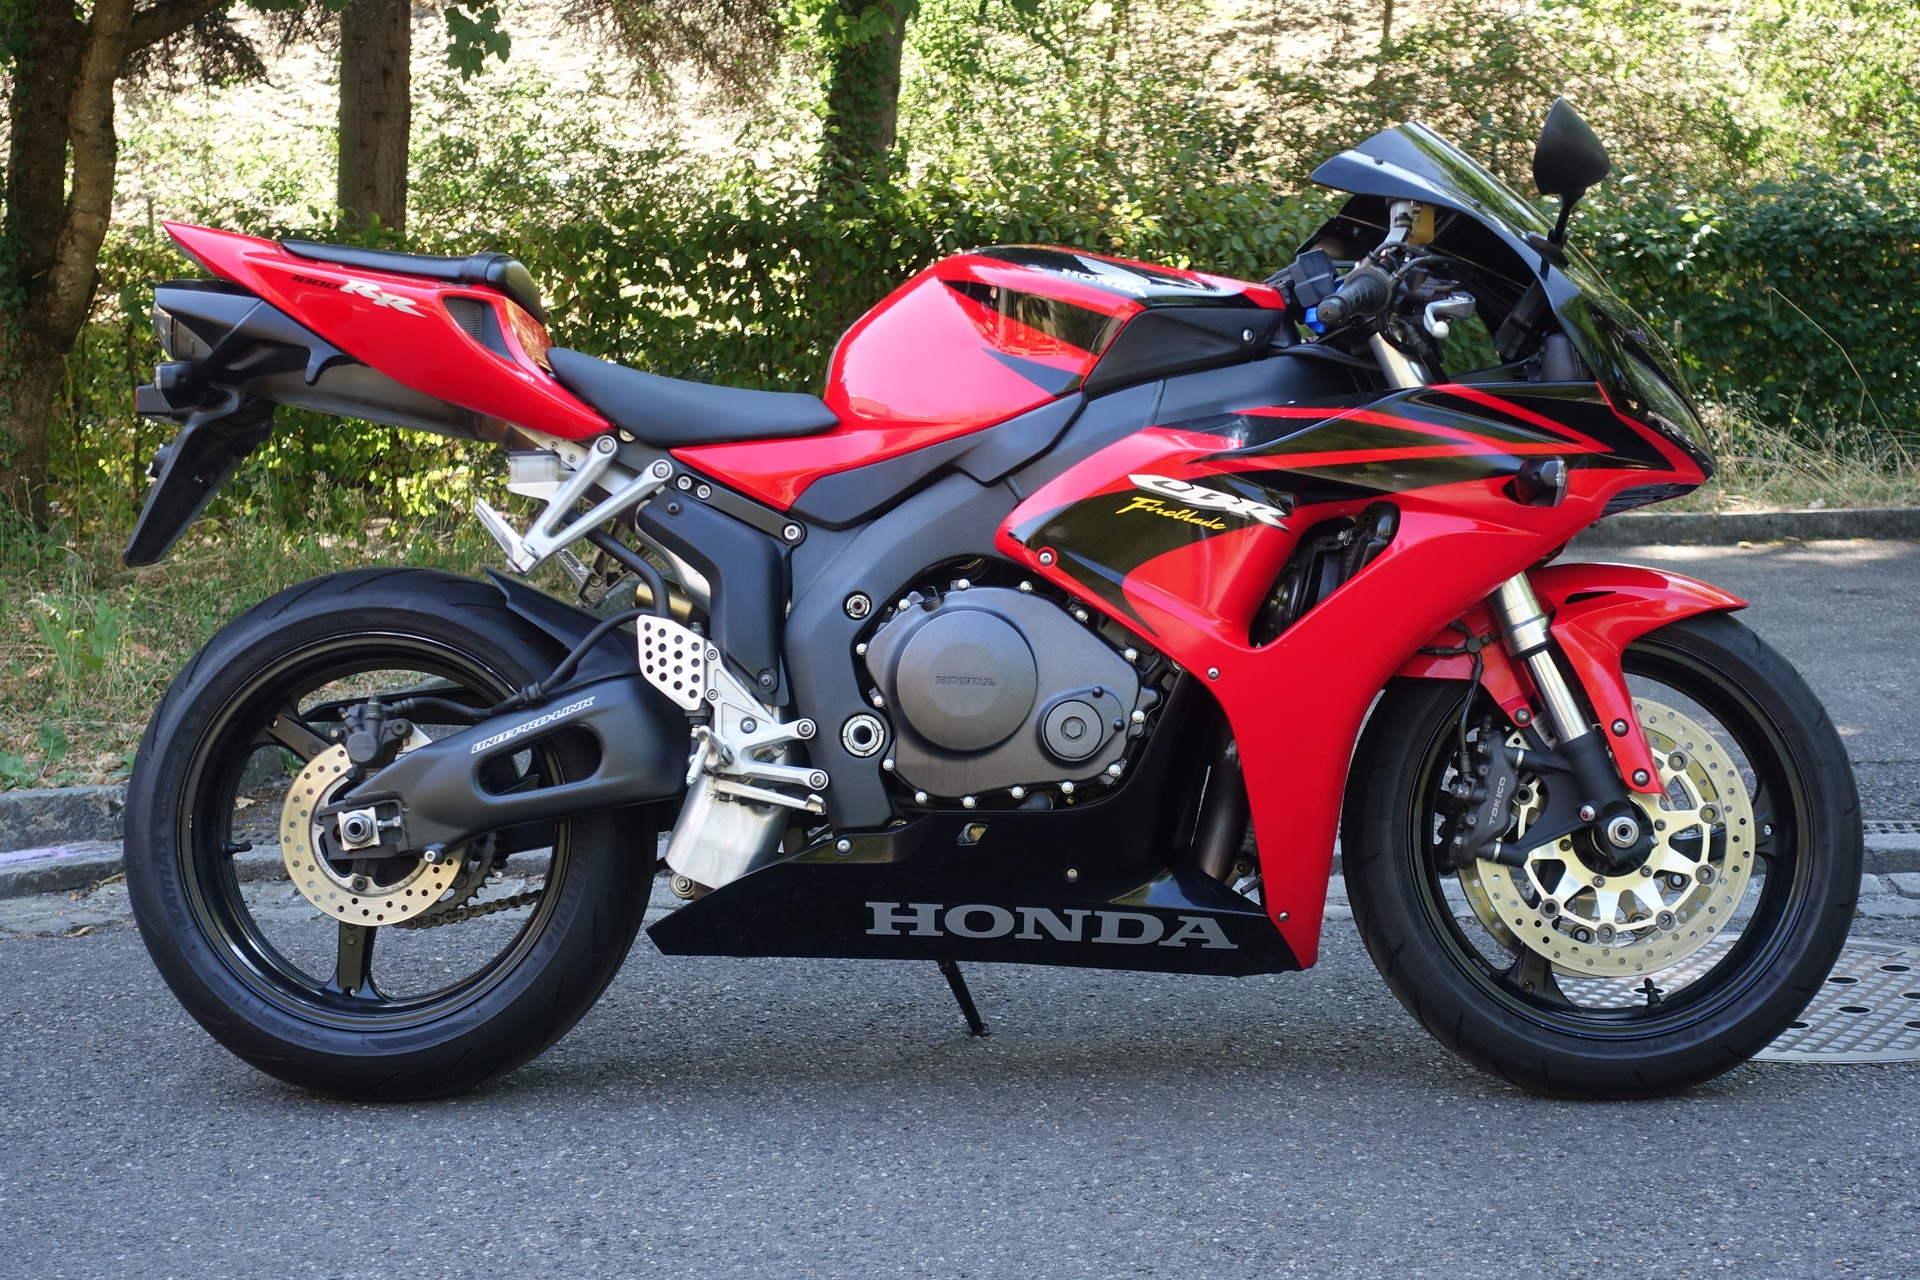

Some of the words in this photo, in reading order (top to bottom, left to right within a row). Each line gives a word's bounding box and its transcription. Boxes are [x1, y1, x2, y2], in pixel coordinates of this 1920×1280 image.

[340, 279, 427, 318] RR
[1062, 268, 1148, 298] HONDA
[1115, 496, 1227, 530] Fireblade
[935, 675, 996, 686] HONDA
[1489, 776, 1507, 826] TOKICO
[865, 901, 1239, 949] HONDA
